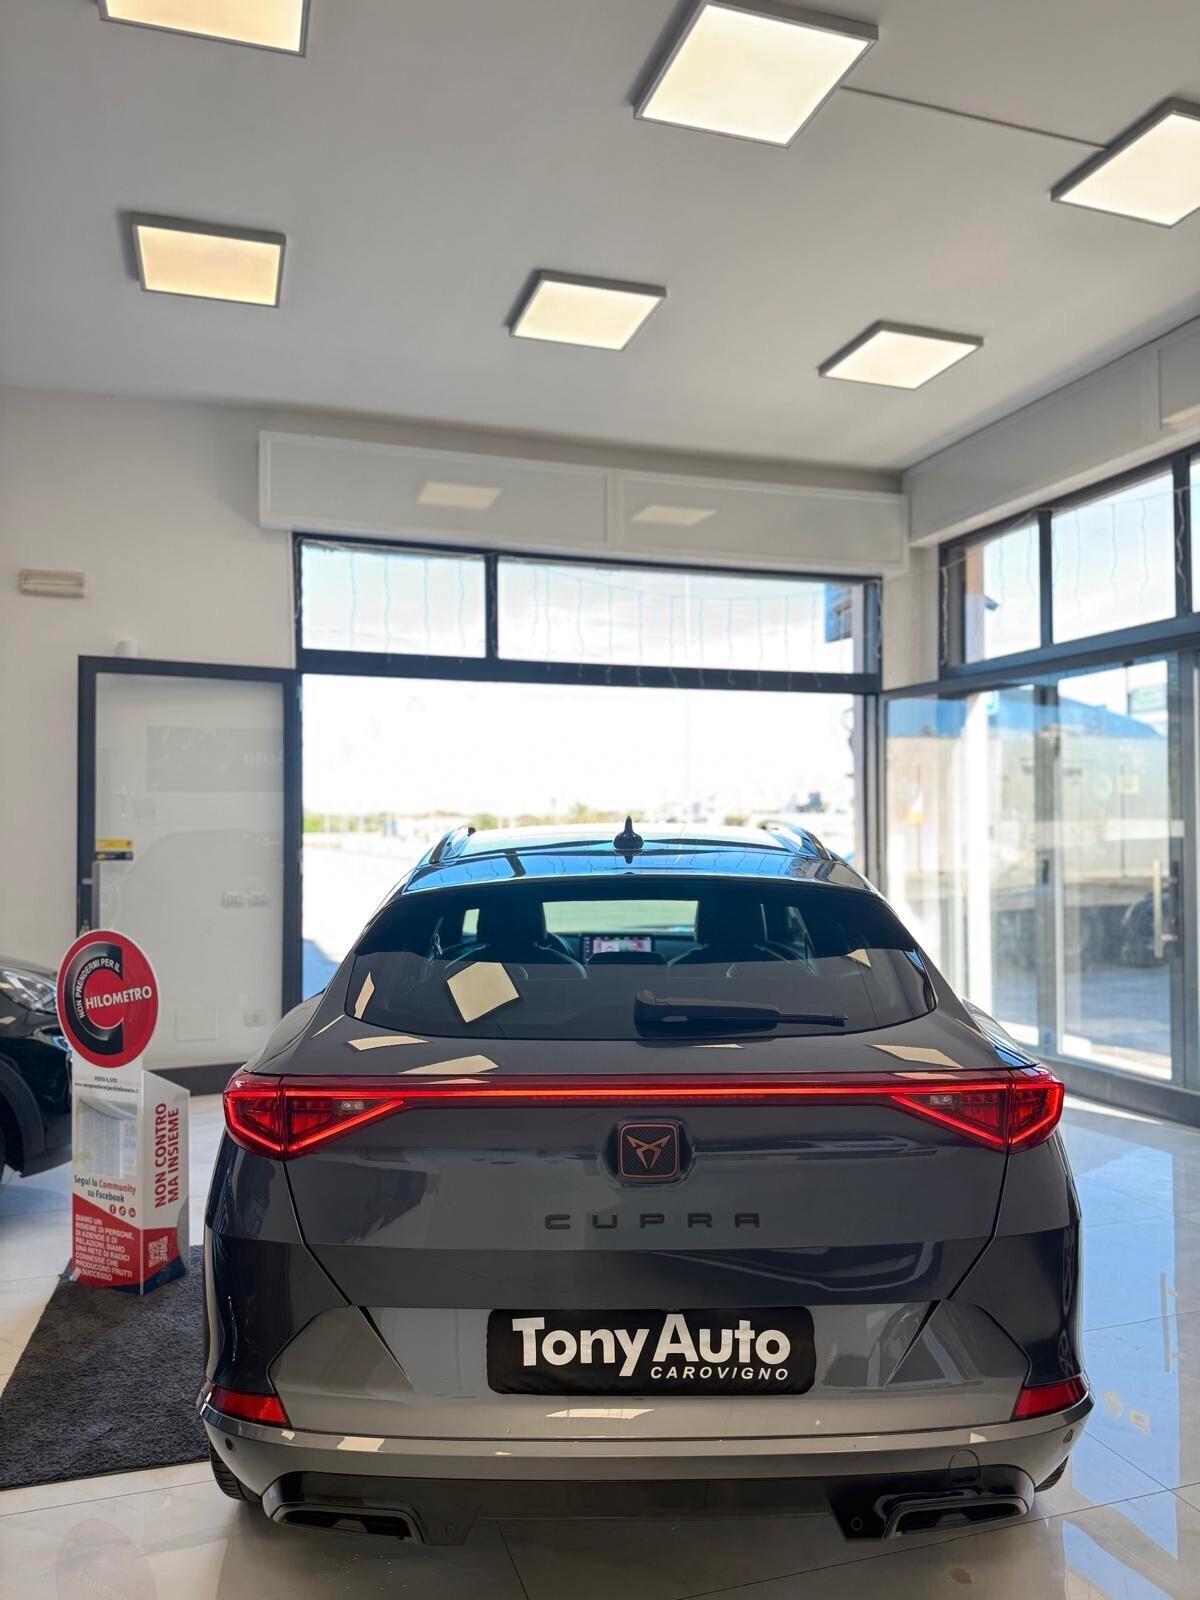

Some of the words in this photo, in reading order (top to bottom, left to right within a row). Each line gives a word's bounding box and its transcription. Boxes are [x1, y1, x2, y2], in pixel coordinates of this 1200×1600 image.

[100, 958, 114, 969] PER
[114, 962, 121, 973] IL
[75, 958, 101, 999] PRENDERMI
[75, 1000, 86, 1019] NON
[155, 1102, 167, 1168] CONTRO
[168, 1107, 179, 1173] INSIEME
[73, 1174, 91, 1187] Segui
[92, 1178, 98, 1187] la
[99, 1179, 137, 1196] Community
[154, 1171, 167, 1209] NON
[168, 1175, 179, 1204] MA
[95, 1190, 125, 1202] Facebook
[75, 1213, 93, 1224] SIAMO
[544, 1212, 760, 1230] CUPRA
[111, 1267, 133, 1279] FRUTTI
[650, 1366, 790, 1381] CAROVIGNO
